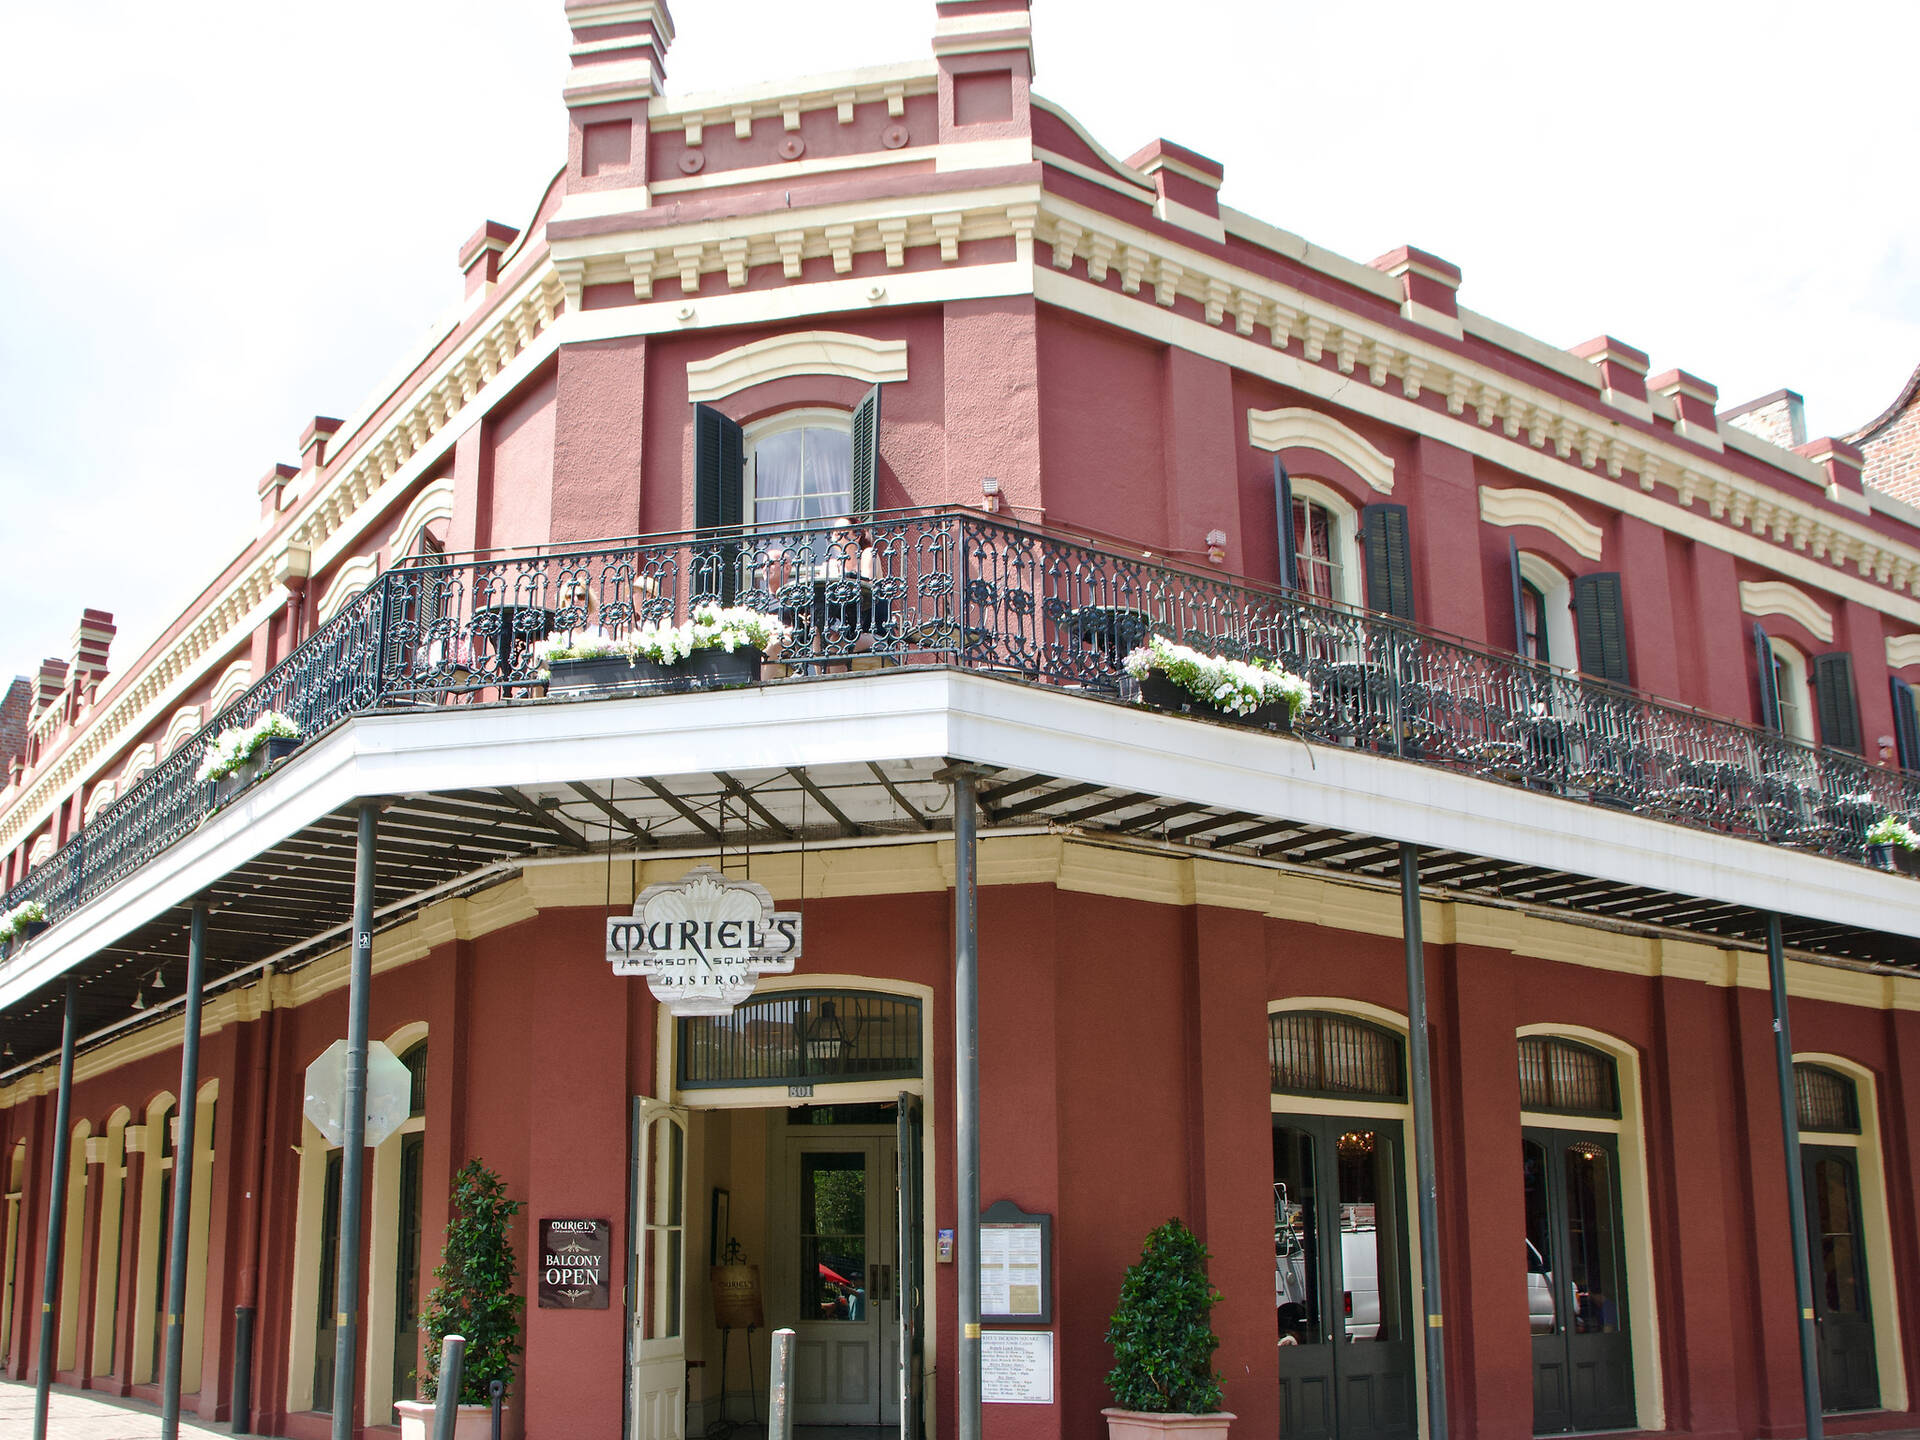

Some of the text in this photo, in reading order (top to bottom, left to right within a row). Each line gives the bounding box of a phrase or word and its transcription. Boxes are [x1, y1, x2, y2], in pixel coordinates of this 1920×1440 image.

[611, 918, 796, 971] MURIEL'S
[621, 955, 786, 969] JACKSON SQUARE
[664, 974, 739, 986] BISTRO
[552, 1221, 596, 1234] MURIEL'S
[546, 1255, 601, 1266] BALCONY
[546, 1268, 599, 1285] OPEN
